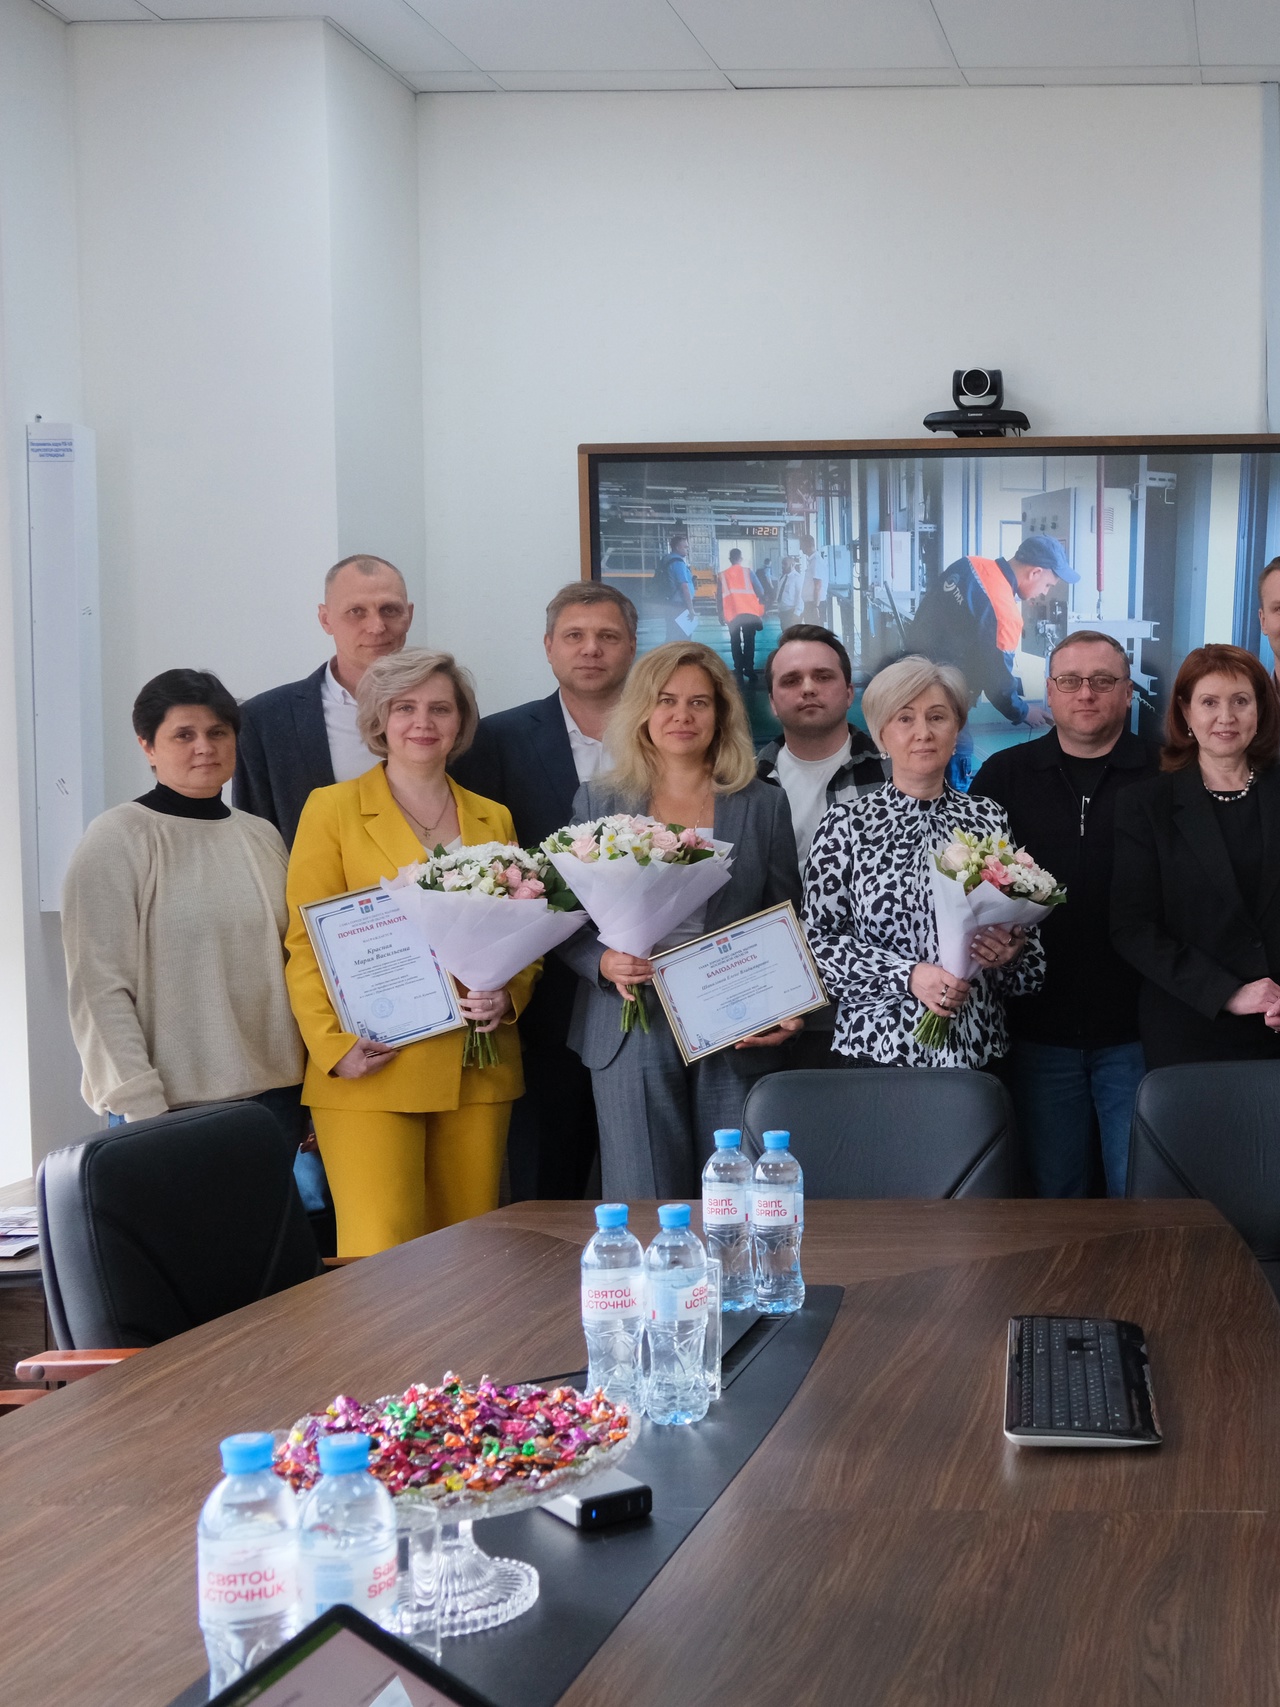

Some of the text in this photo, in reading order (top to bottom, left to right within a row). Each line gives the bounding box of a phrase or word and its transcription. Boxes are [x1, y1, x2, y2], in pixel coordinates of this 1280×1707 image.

[337, 924, 375, 939] ПОЧЕТНАЯ
[375, 915, 408, 928] ГРАМОТА
[706, 953, 758, 979] БЛАГОДАРНОСТЬ
